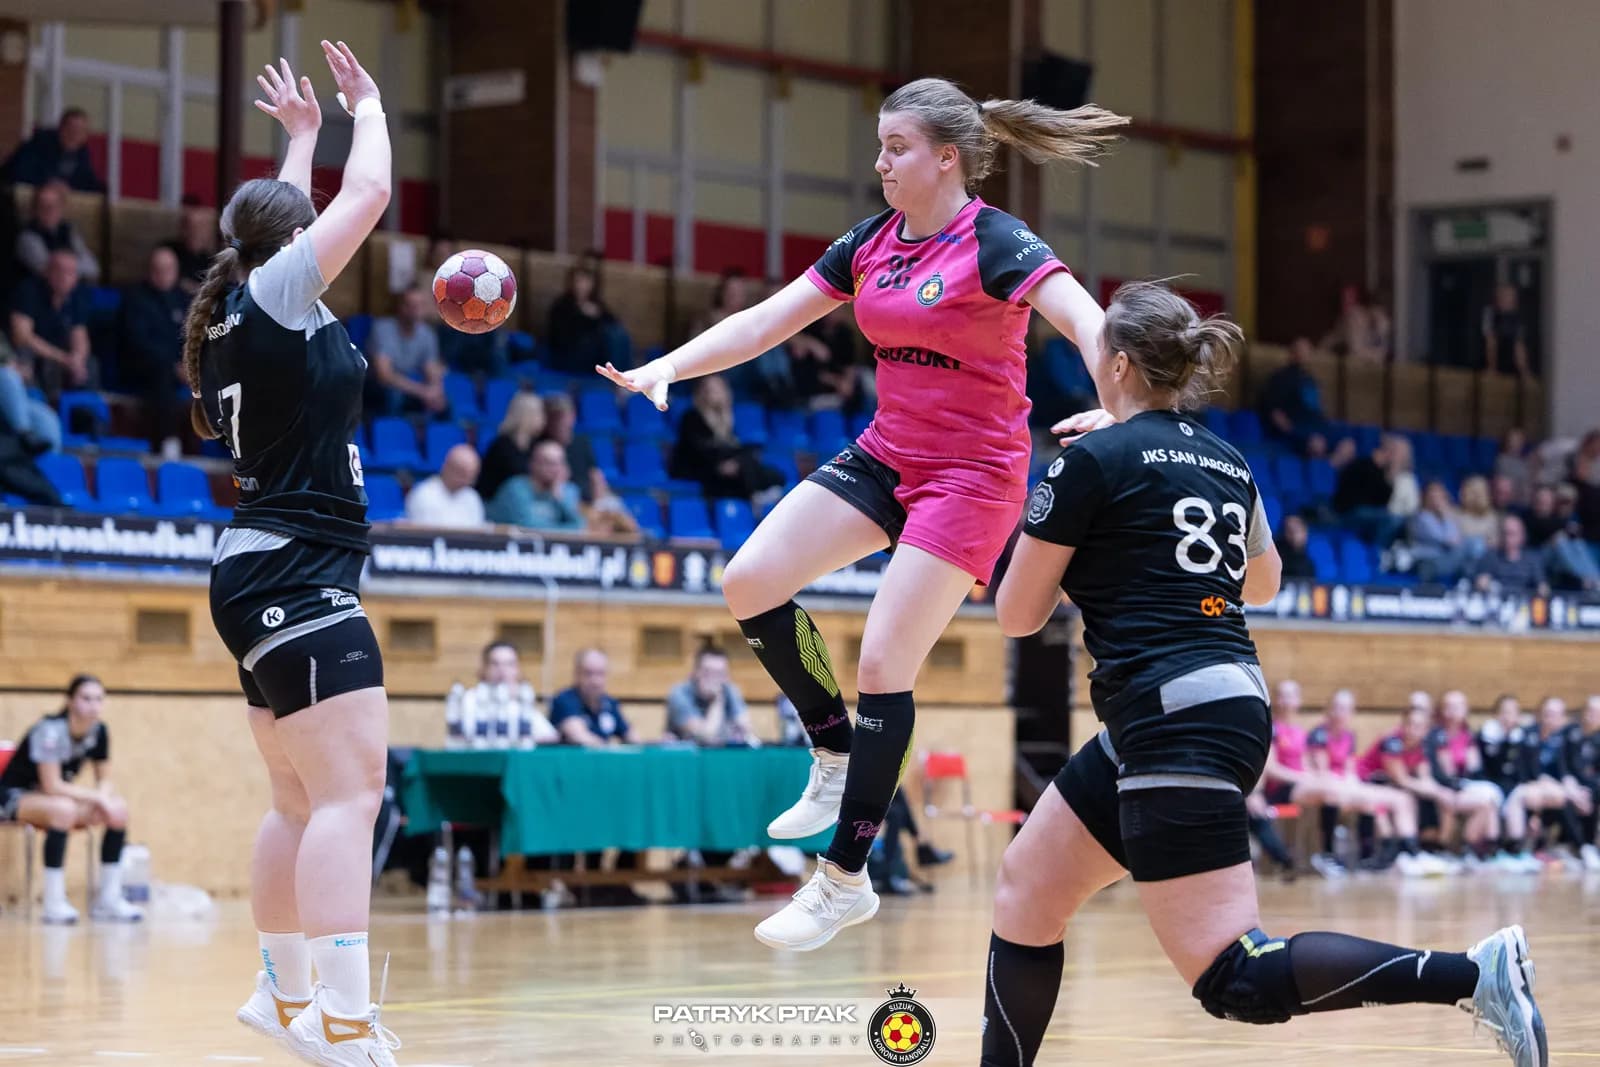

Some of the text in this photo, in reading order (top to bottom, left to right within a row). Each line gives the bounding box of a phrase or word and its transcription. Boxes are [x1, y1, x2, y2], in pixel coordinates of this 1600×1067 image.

[877, 346, 960, 370] SUZUKI
[217, 382, 242, 459] 7
[1141, 448, 1168, 464] JKS
[1168, 449, 1197, 465] SAN
[1172, 497, 1247, 581] 83
